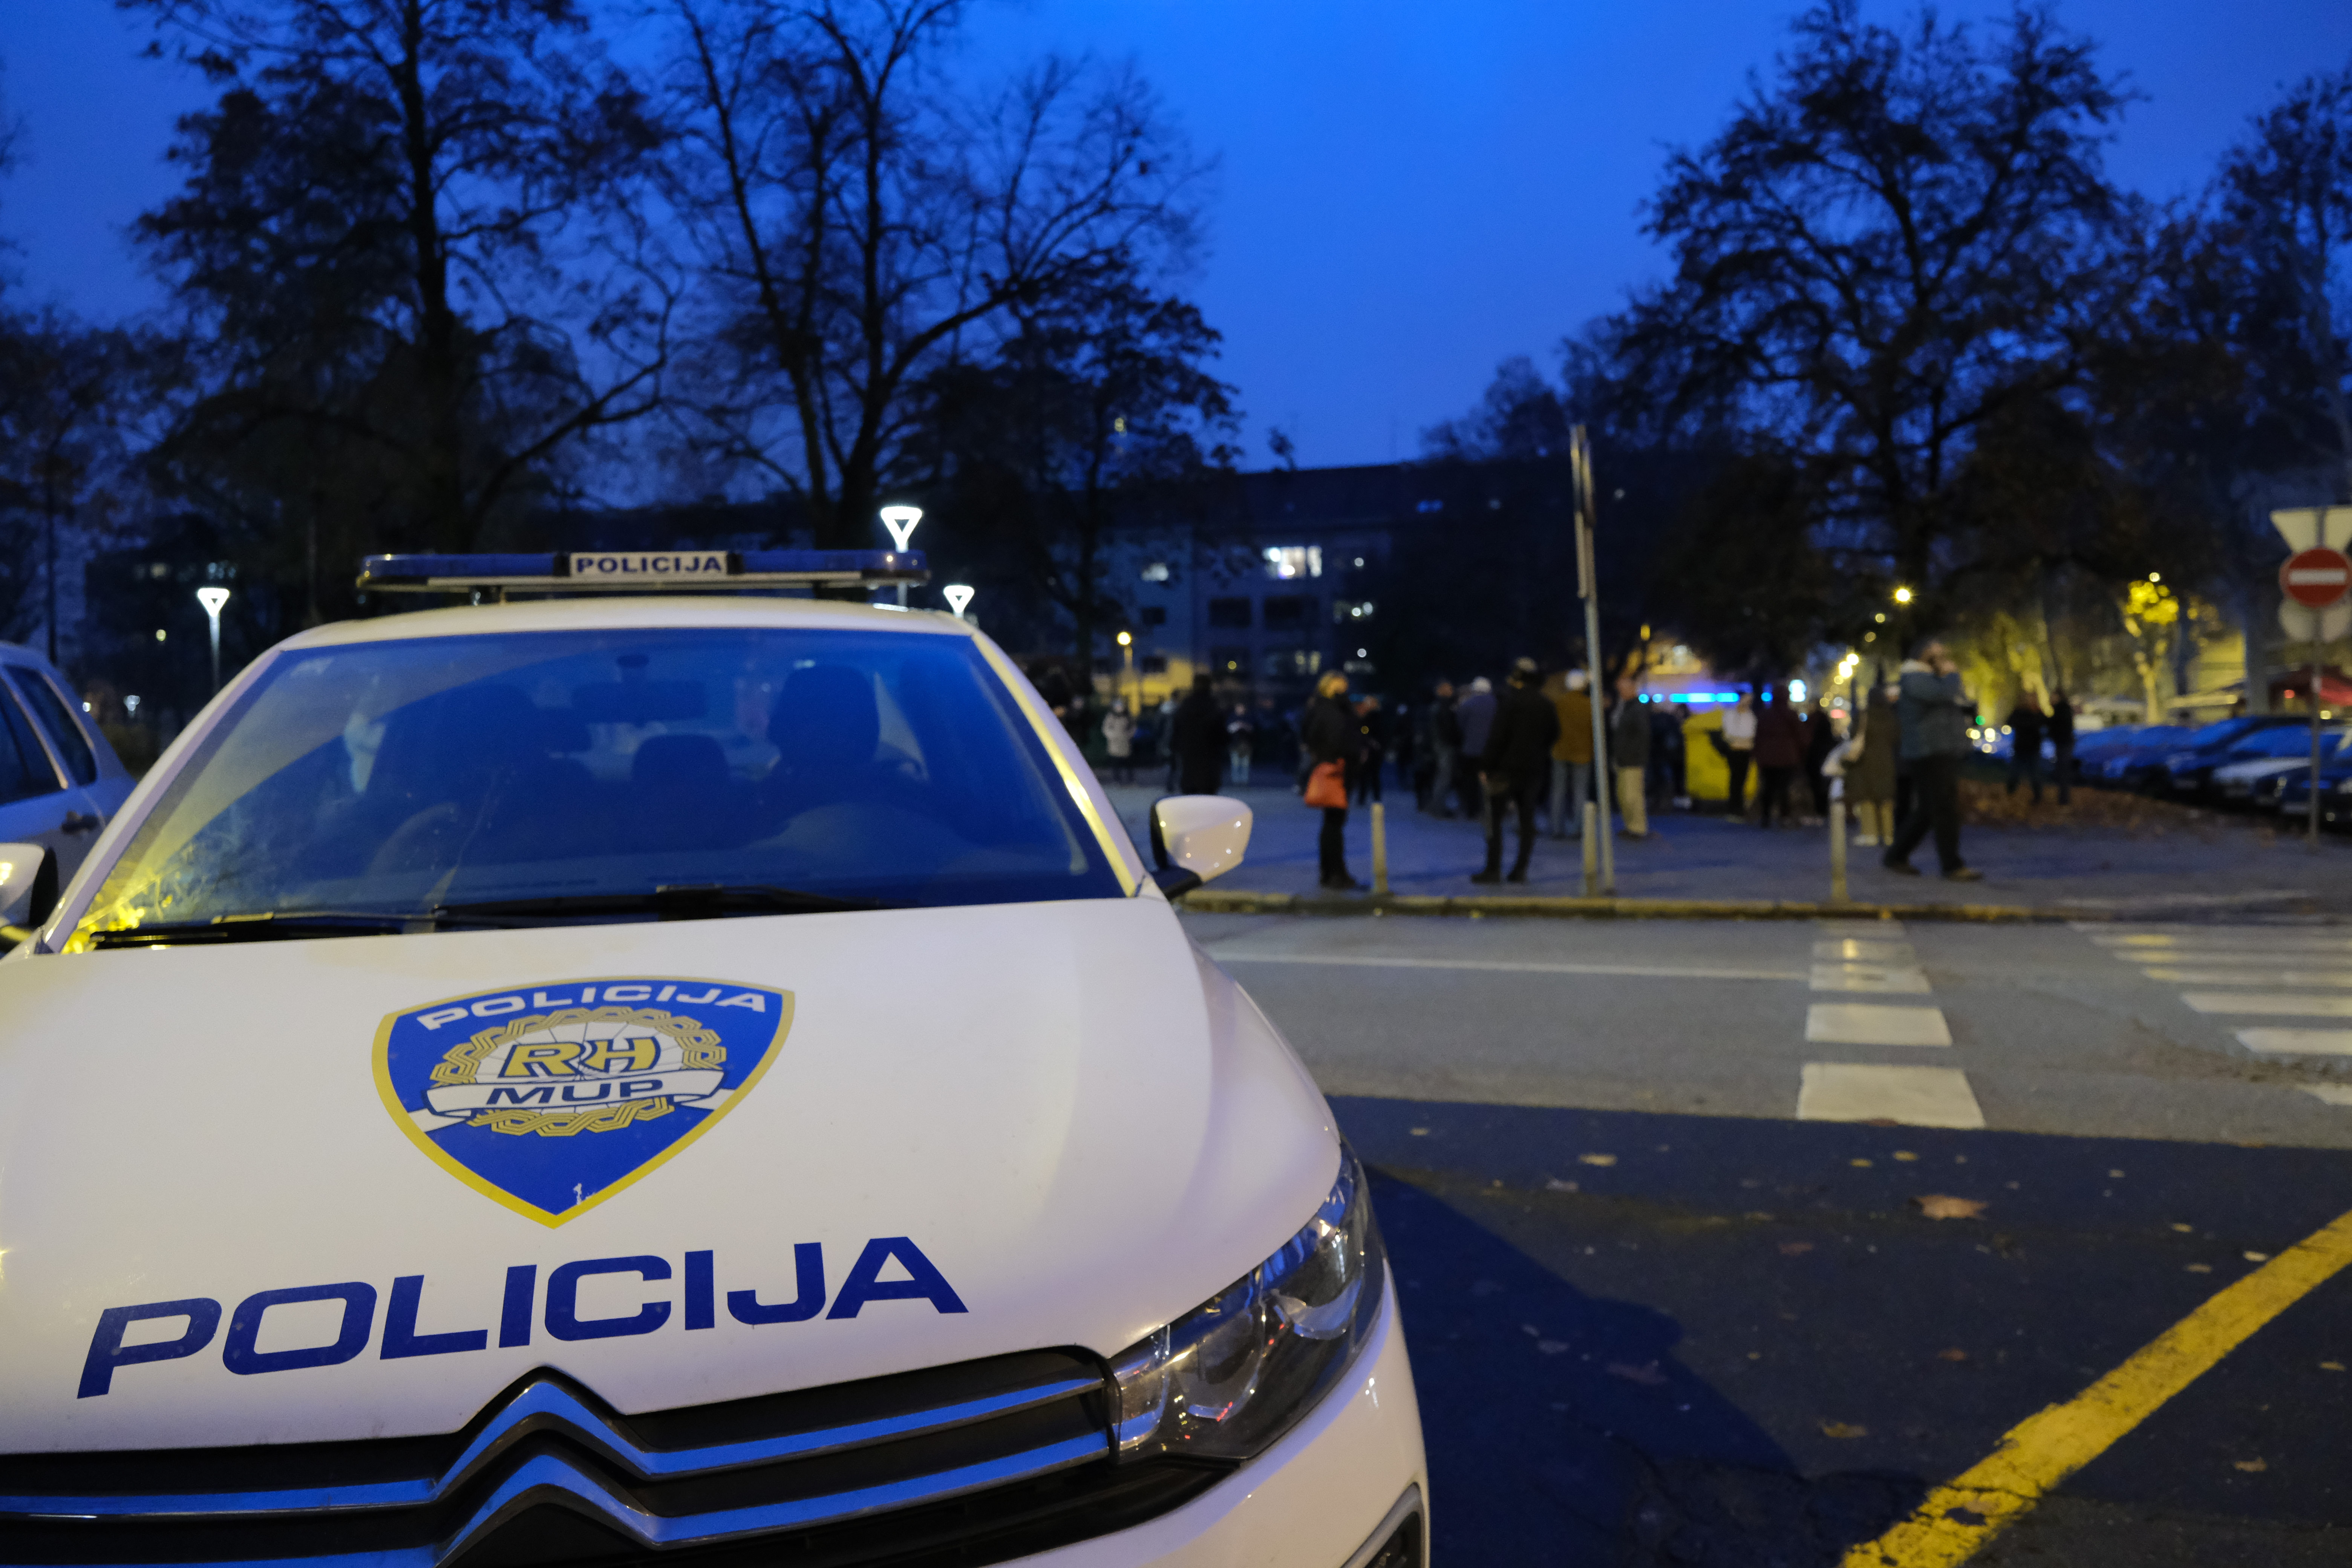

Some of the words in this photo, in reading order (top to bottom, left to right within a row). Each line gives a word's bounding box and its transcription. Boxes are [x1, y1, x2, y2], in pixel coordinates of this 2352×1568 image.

[576, 556, 722, 573] POLICIJA
[417, 985, 766, 1031] POLICIJA
[497, 1036, 661, 1079] RH
[486, 1079, 663, 1105] MUP
[77, 1236, 969, 1399] POLICIJA
